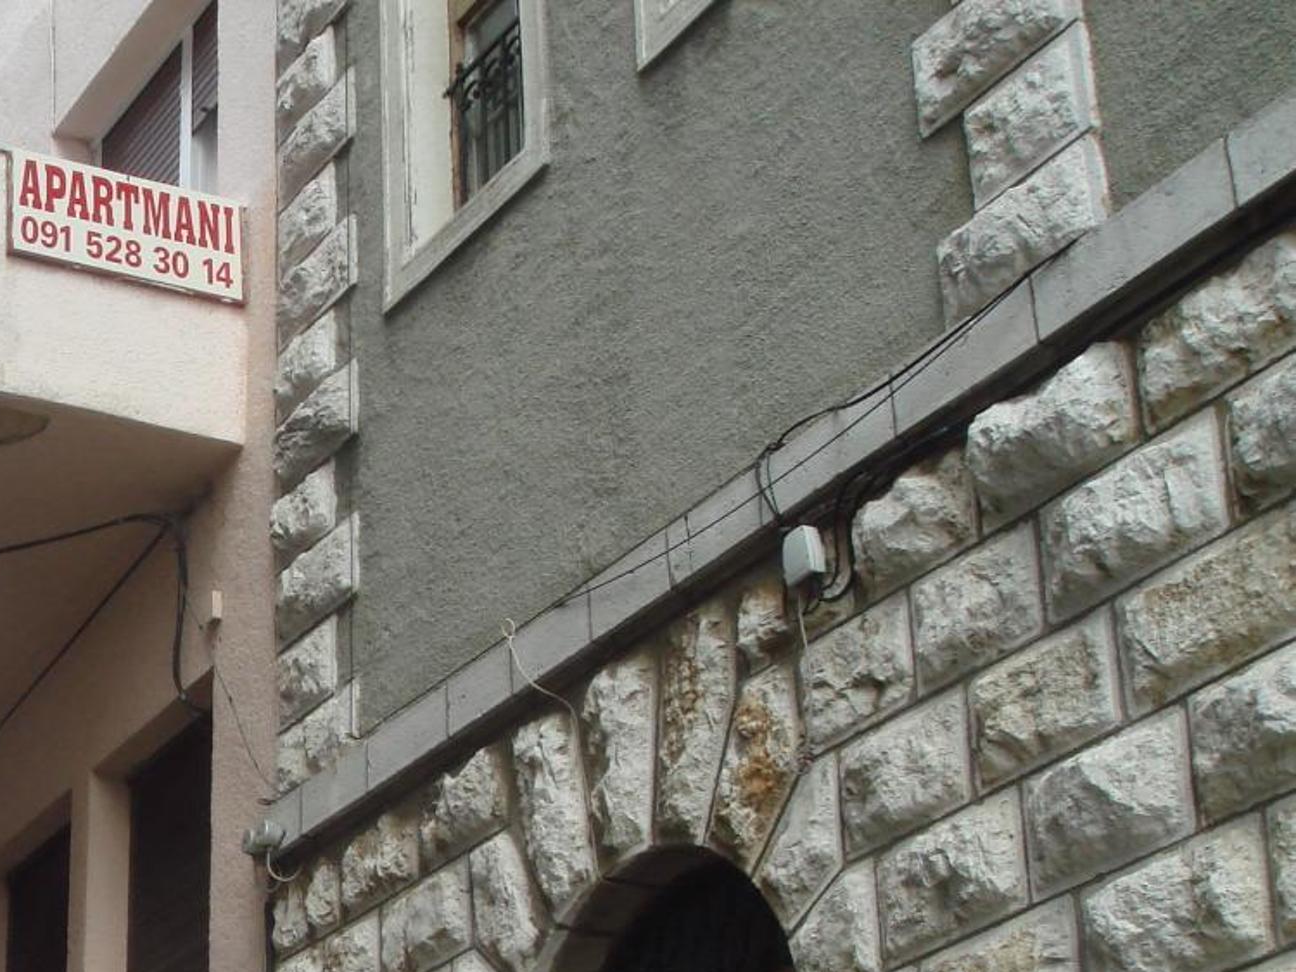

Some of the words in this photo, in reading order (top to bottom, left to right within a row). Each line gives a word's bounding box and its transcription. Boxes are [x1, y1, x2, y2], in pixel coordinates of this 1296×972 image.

[19, 160, 235, 254] APARTMANI
[20, 216, 72, 252] 091
[86, 231, 142, 268] 528
[153, 246, 189, 278] 30
[203, 258, 234, 288] 14
